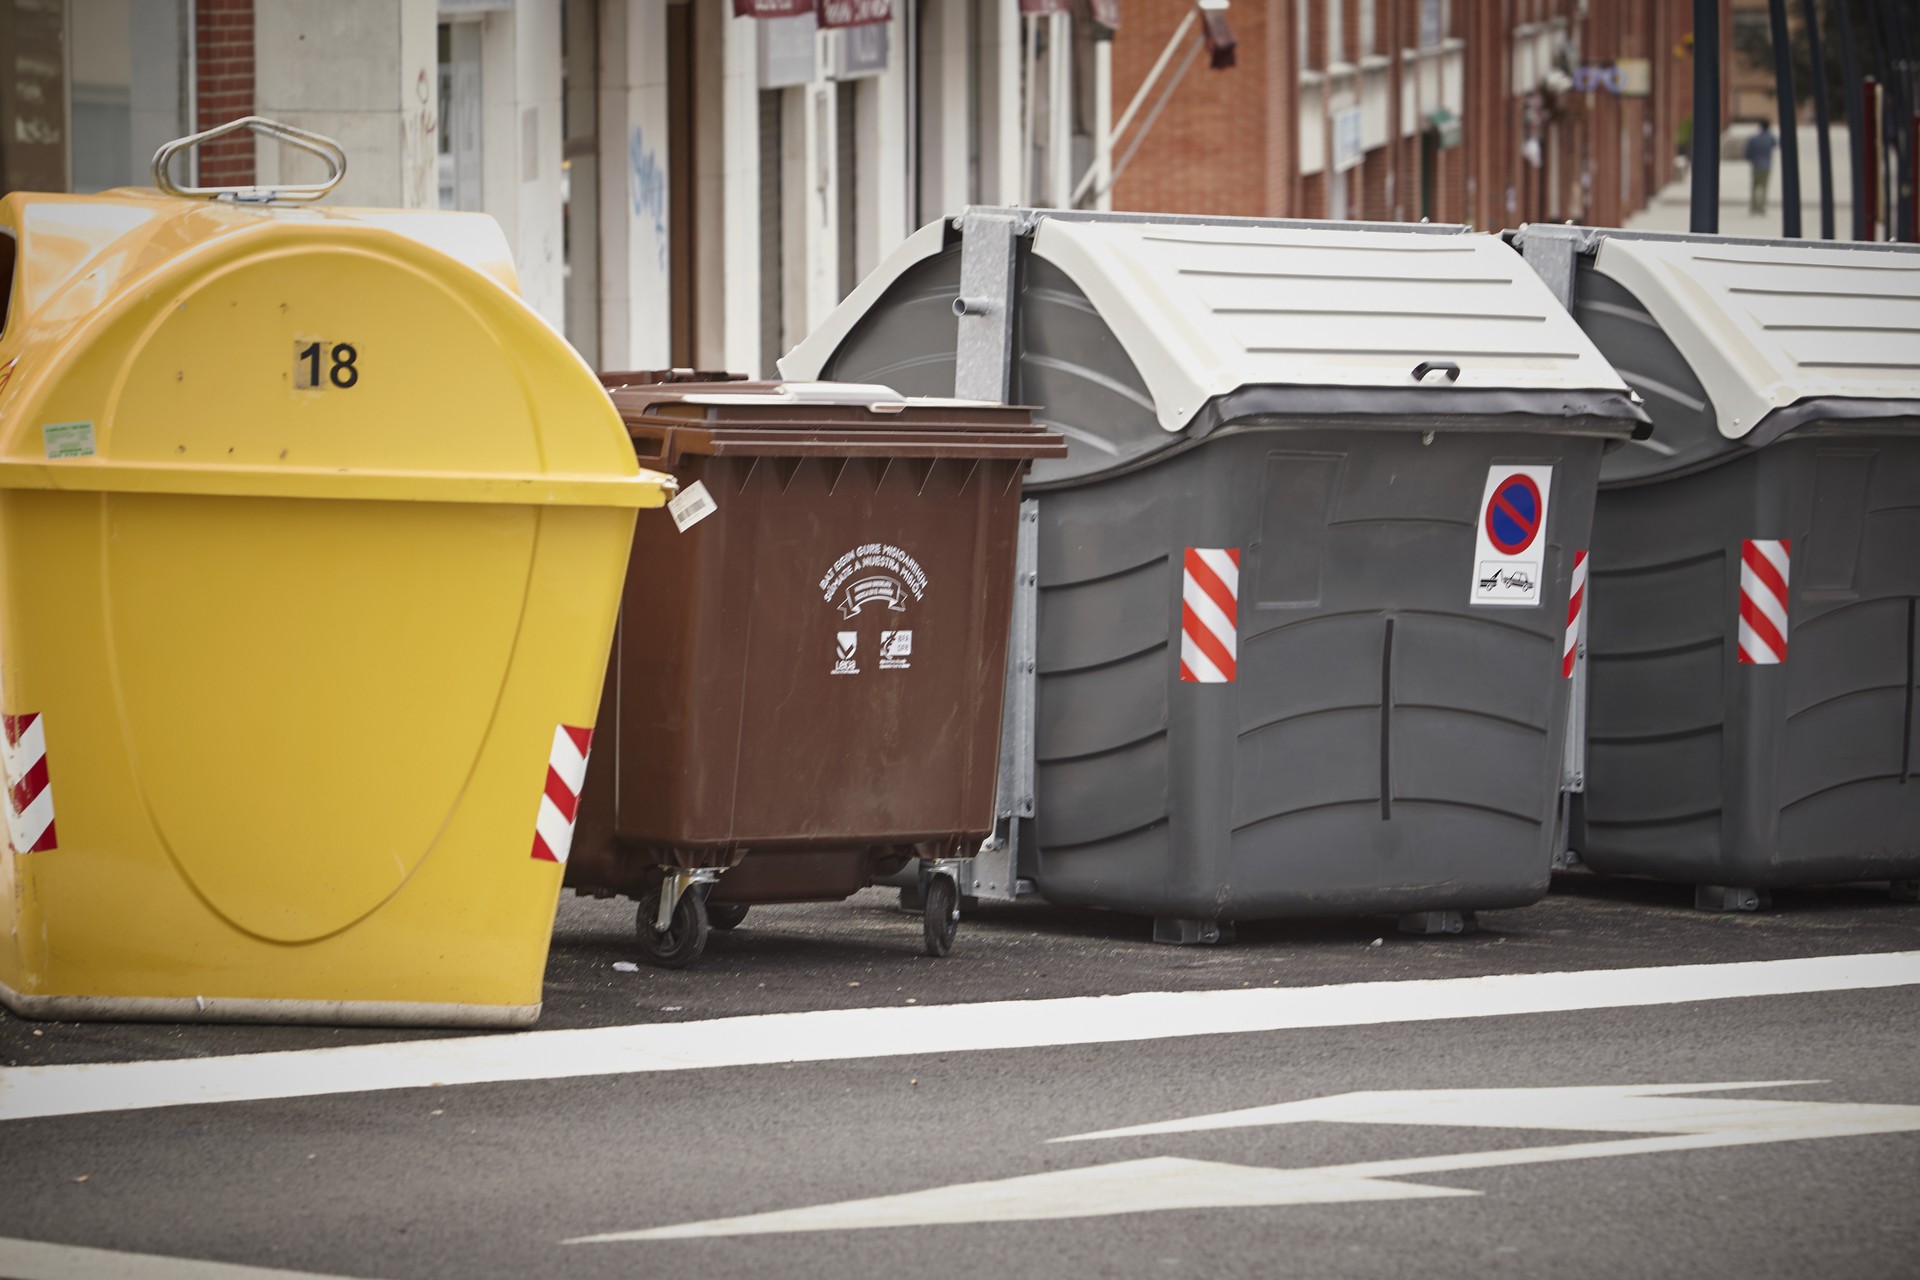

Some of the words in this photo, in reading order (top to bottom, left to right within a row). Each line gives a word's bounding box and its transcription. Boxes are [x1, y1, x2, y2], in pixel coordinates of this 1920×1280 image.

[300, 342, 358, 389] 18
[856, 543, 882, 557] GURE
[854, 560, 863, 572] A
[861, 555, 901, 573] NUESTRA
